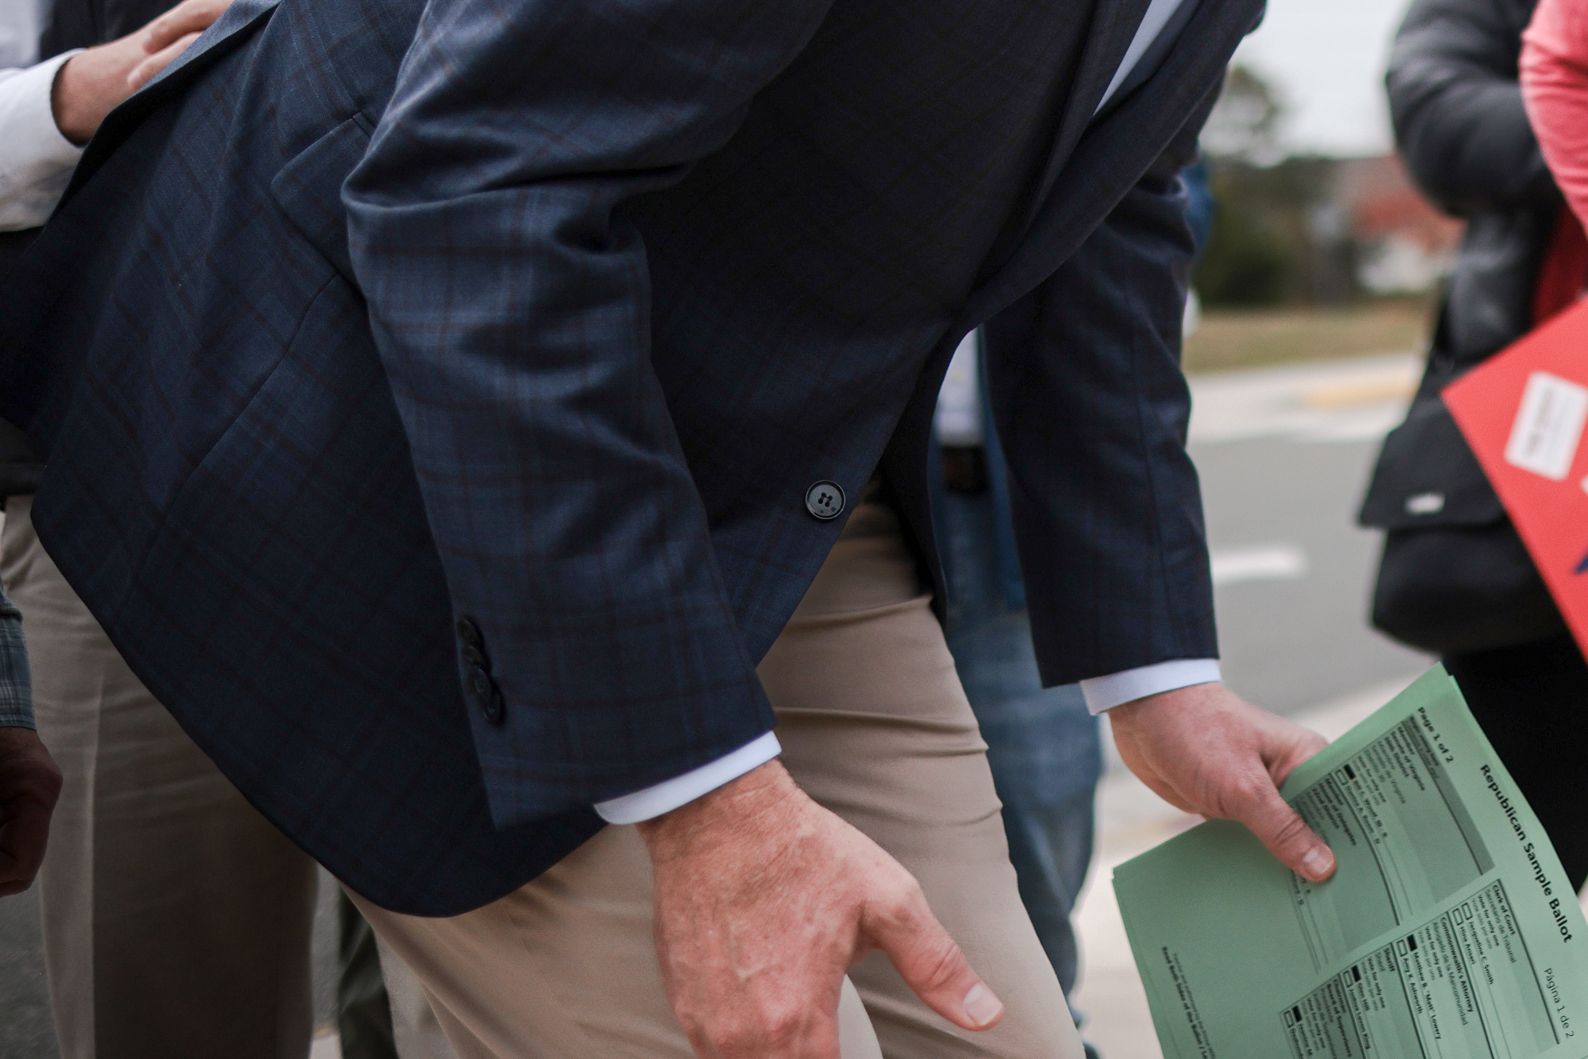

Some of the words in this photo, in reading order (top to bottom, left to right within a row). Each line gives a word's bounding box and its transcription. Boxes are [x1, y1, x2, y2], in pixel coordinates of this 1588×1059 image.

[1397, 727, 1415, 755] Member
[1418, 707, 1434, 732] Page
[1438, 743, 1449, 754] of
[1358, 755, 1367, 768] Vote
[1371, 779, 1380, 791] only
[1378, 792, 1386, 802] one
[1391, 731, 1405, 754] Senate
[1409, 764, 1425, 791] Virginia
[1318, 783, 1333, 804] House
[1337, 812, 1356, 845] Delegates
[1325, 778, 1343, 805] Member
[1322, 805, 1339, 829] District
[1480, 764, 1526, 841] Republican
[1523, 842, 1552, 896] Sample
[1549, 898, 1572, 943] Ballot
[1471, 899, 1479, 912] Vote
[1492, 885, 1503, 904] Clerk
[1501, 905, 1508, 913] of
[1485, 889, 1501, 924] Secretario
[1499, 925, 1505, 934] de
[1503, 935, 1517, 963] Tribunal
[1487, 920, 1495, 934] only
[1504, 914, 1516, 935] Court
[1384, 948, 1395, 972] Sheriff
[1432, 922, 1445, 953] Abogado
[1443, 954, 1449, 963] de
[1448, 971, 1468, 1025] Mancomunidad
[1441, 917, 1463, 979] Commonwealth's
[1460, 980, 1473, 1012] Attorney
[1469, 921, 1484, 955] Jacqueline
[1484, 964, 1494, 985] Smith
[1176, 983, 1186, 1001] Sides
[1186, 1011, 1194, 1023] the
[1191, 1024, 1202, 1045] Ballot
[1333, 979, 1346, 1013] Chairman
[1357, 983, 1365, 998] Glen
[1362, 999, 1370, 1011] Hill
[1410, 982, 1423, 1014] Ashworth
[1413, 952, 1424, 981] Matthew
[1430, 1014, 1441, 1039] Lowery
[1544, 967, 1560, 1004] Página
[1560, 1015, 1569, 1029] de
[1326, 984, 1337, 1005] Board
[1337, 1016, 1352, 1057] Supervisors
